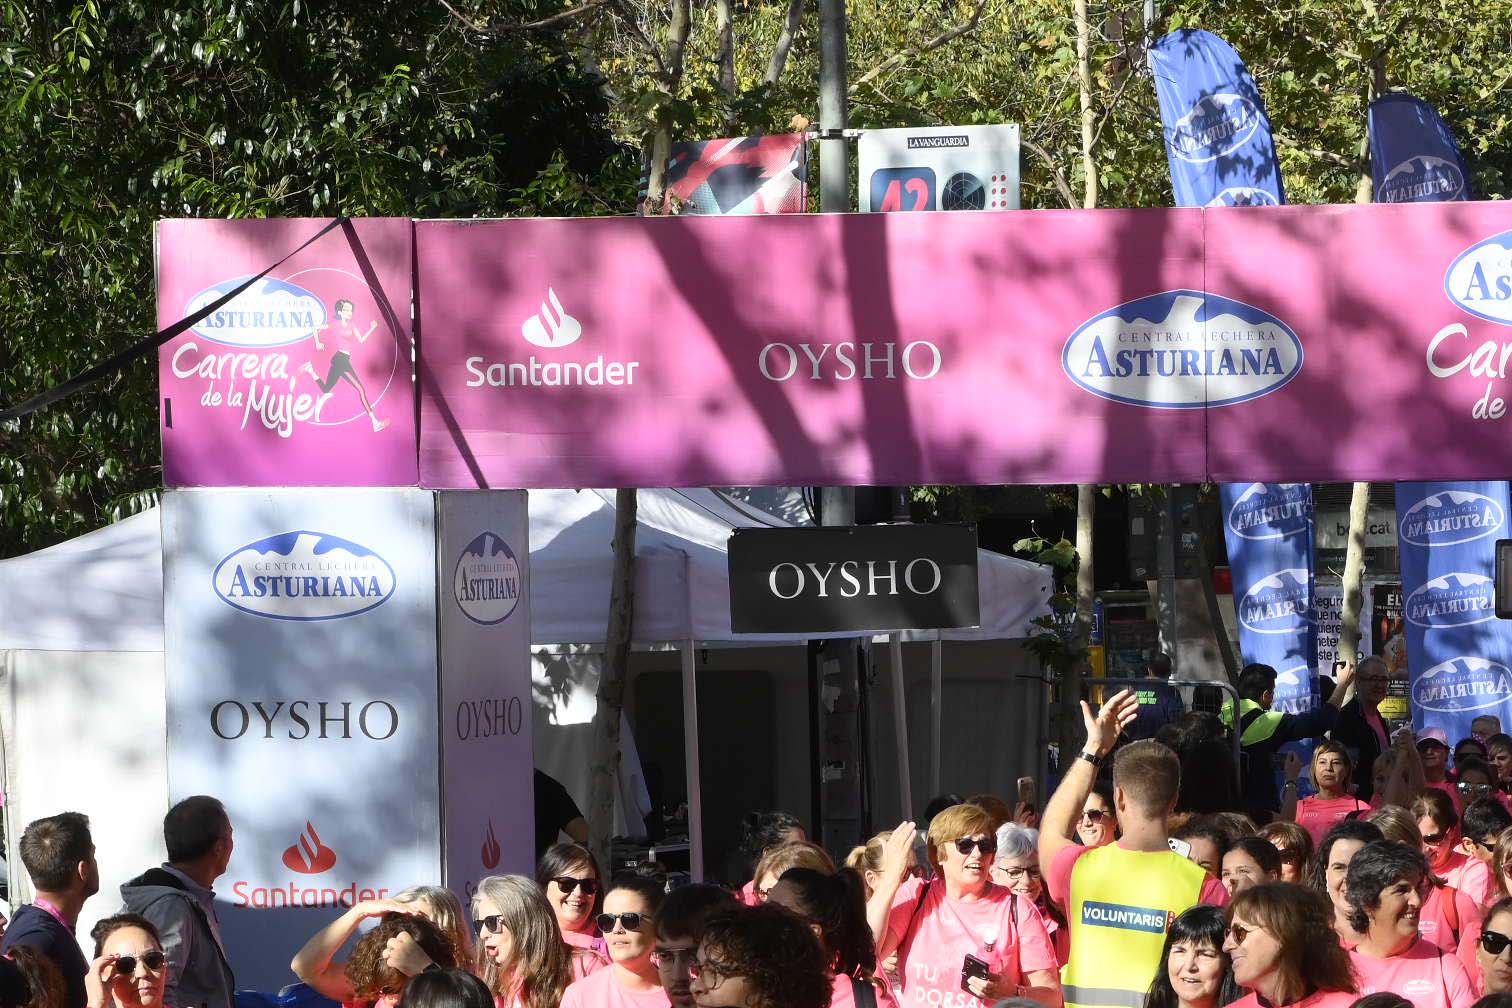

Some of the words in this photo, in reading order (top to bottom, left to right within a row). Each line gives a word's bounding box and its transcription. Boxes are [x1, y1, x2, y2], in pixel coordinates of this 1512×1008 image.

[1118, 330, 1192, 343] CENTRAL
[1208, 329, 1276, 342] ECHERA
[172, 341, 289, 380] Carrera
[466, 355, 639, 388] Santander
[758, 341, 942, 381] OYSHO
[1082, 335, 1285, 378] ASTURIANA
[200, 381, 223, 407] de
[227, 380, 243, 407] la
[240, 377, 334, 438] Mujer
[1472, 383, 1506, 419] de
[227, 562, 383, 599] ASTURIANA
[255, 561, 313, 572] CENTRAL
[459, 567, 516, 602] ASTURIANA
[768, 558, 941, 600] OYSHO
[210, 700, 399, 740] OYSHO
[457, 696, 522, 740] OYSHO
[232, 881, 389, 910] Santander
[1083, 906, 1164, 928] VOLUNTARIS
[914, 962, 937, 984] TU
